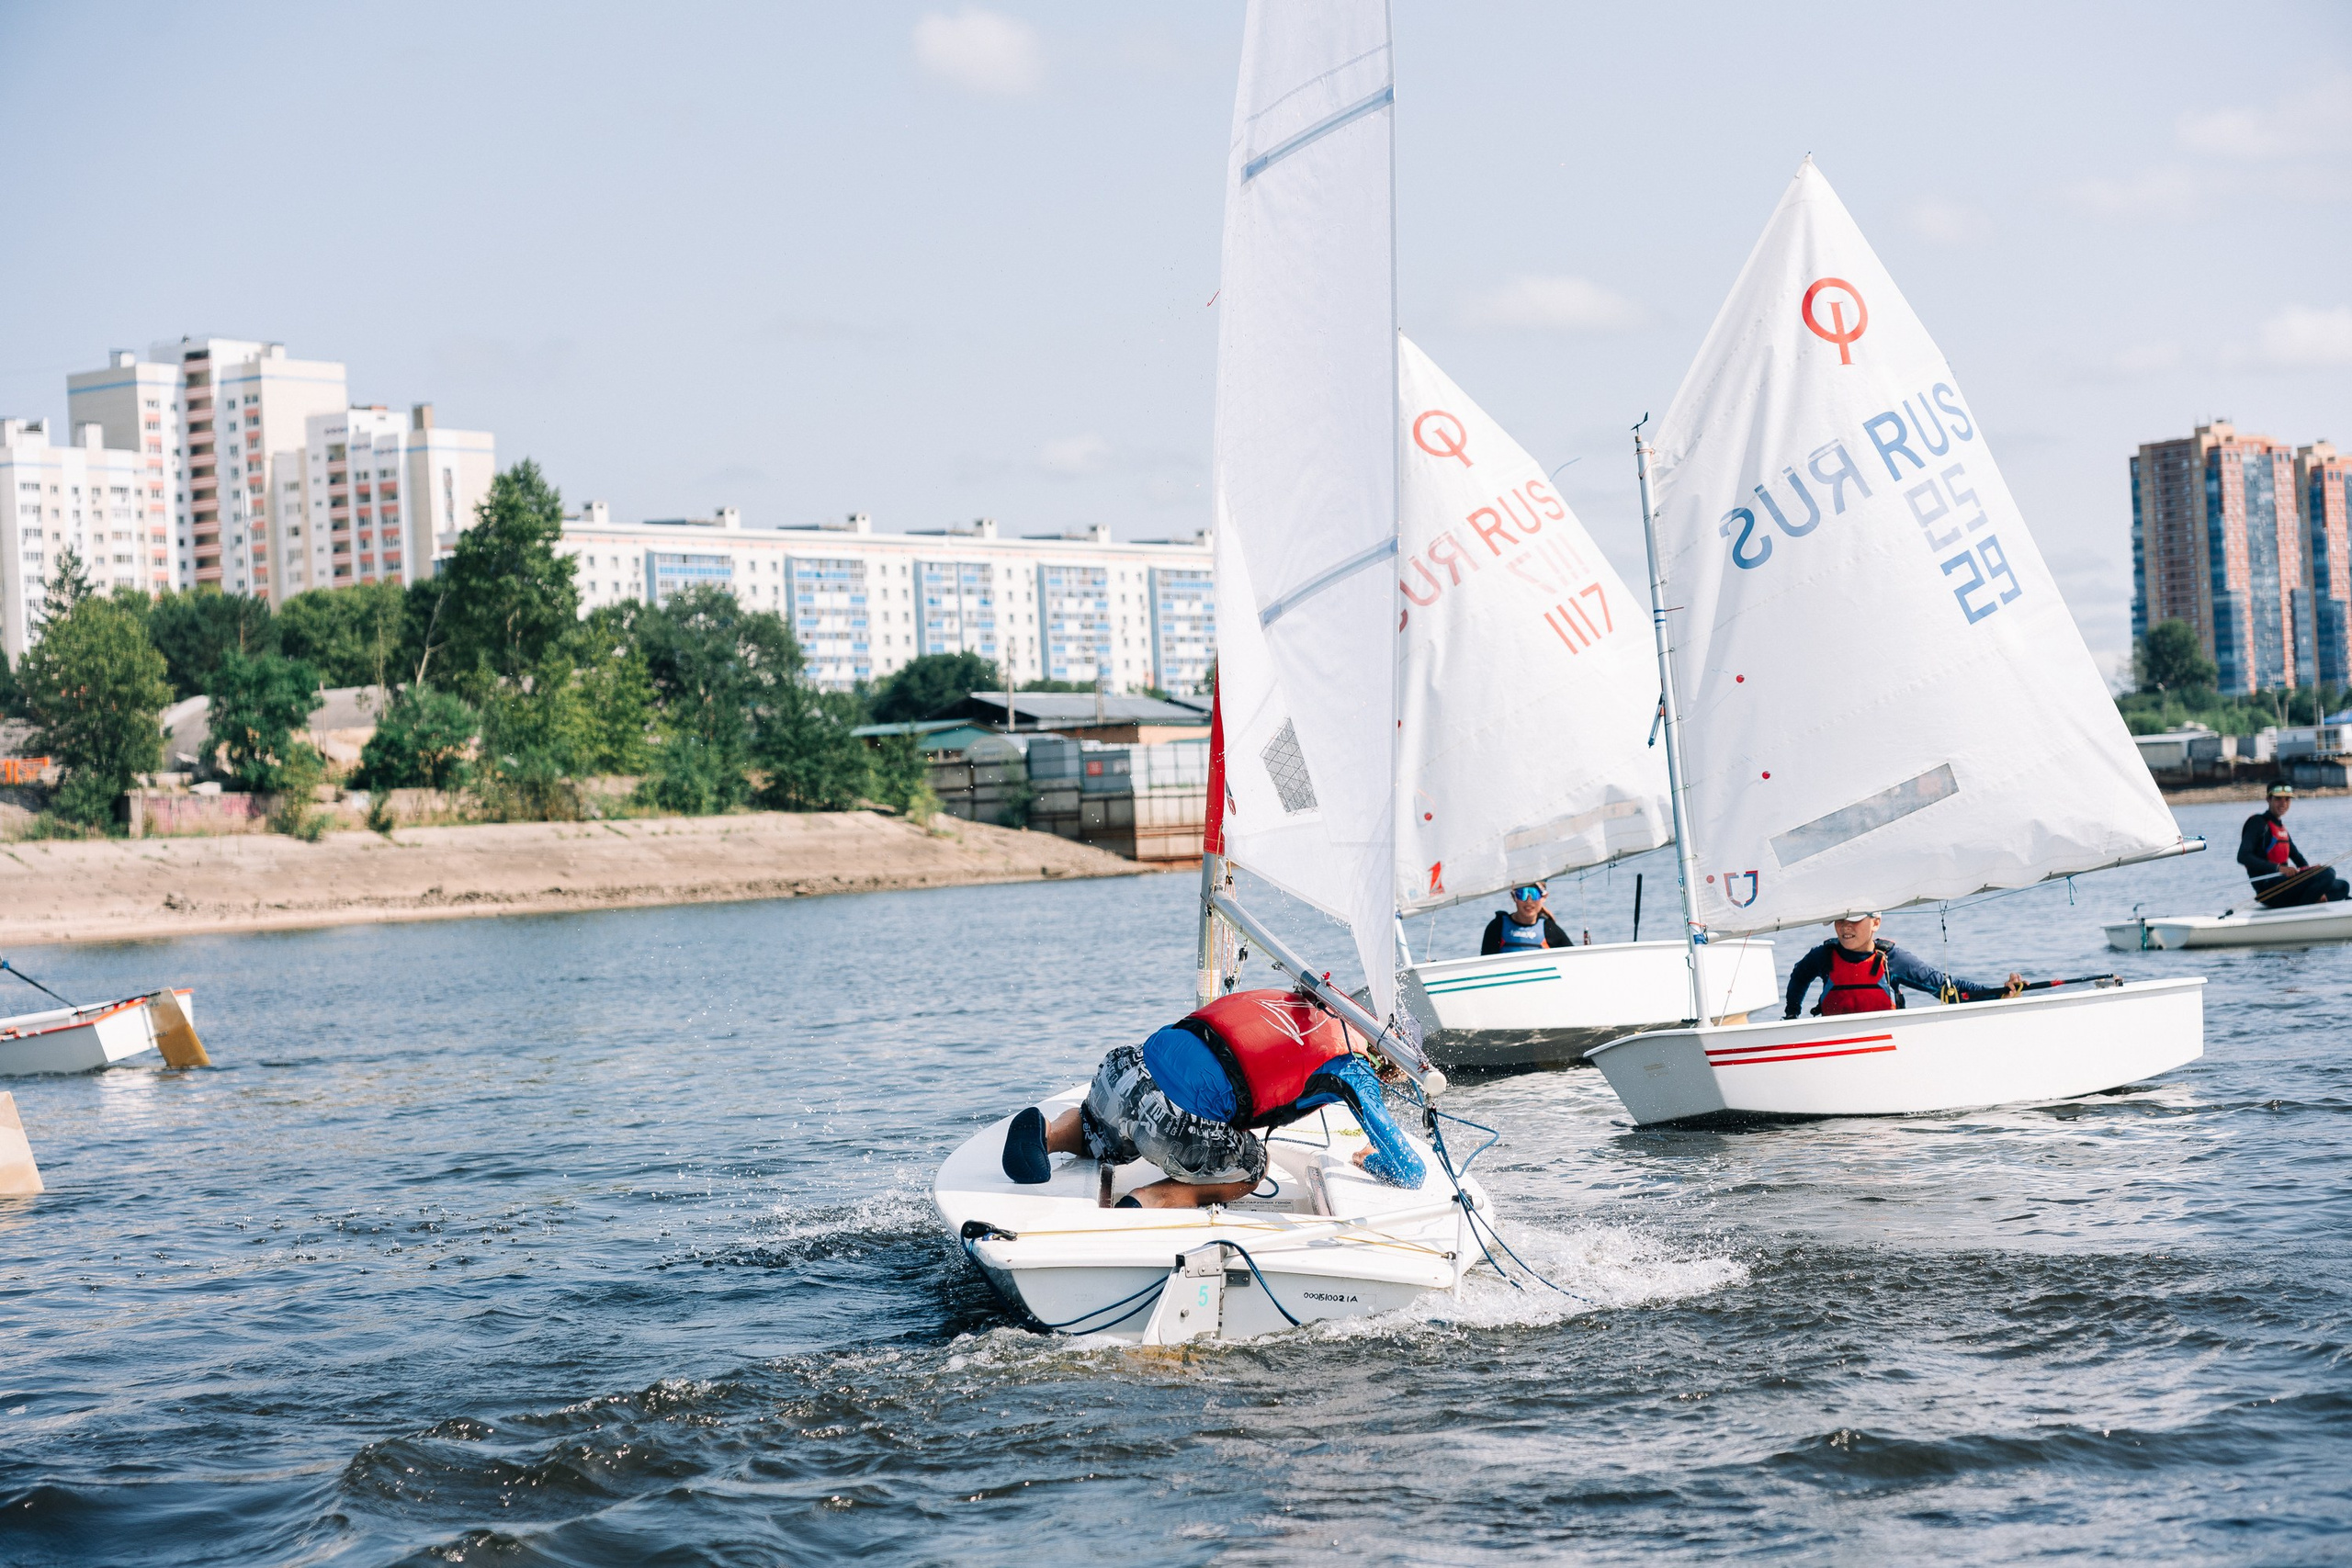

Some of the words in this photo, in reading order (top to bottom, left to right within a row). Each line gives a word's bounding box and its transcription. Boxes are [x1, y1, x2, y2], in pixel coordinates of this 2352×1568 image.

[1862, 382, 1973, 482] RUS
[1466, 479, 1565, 557] RUS
[1544, 581, 1613, 655] 1117
[1198, 1285, 1209, 1306] 5
